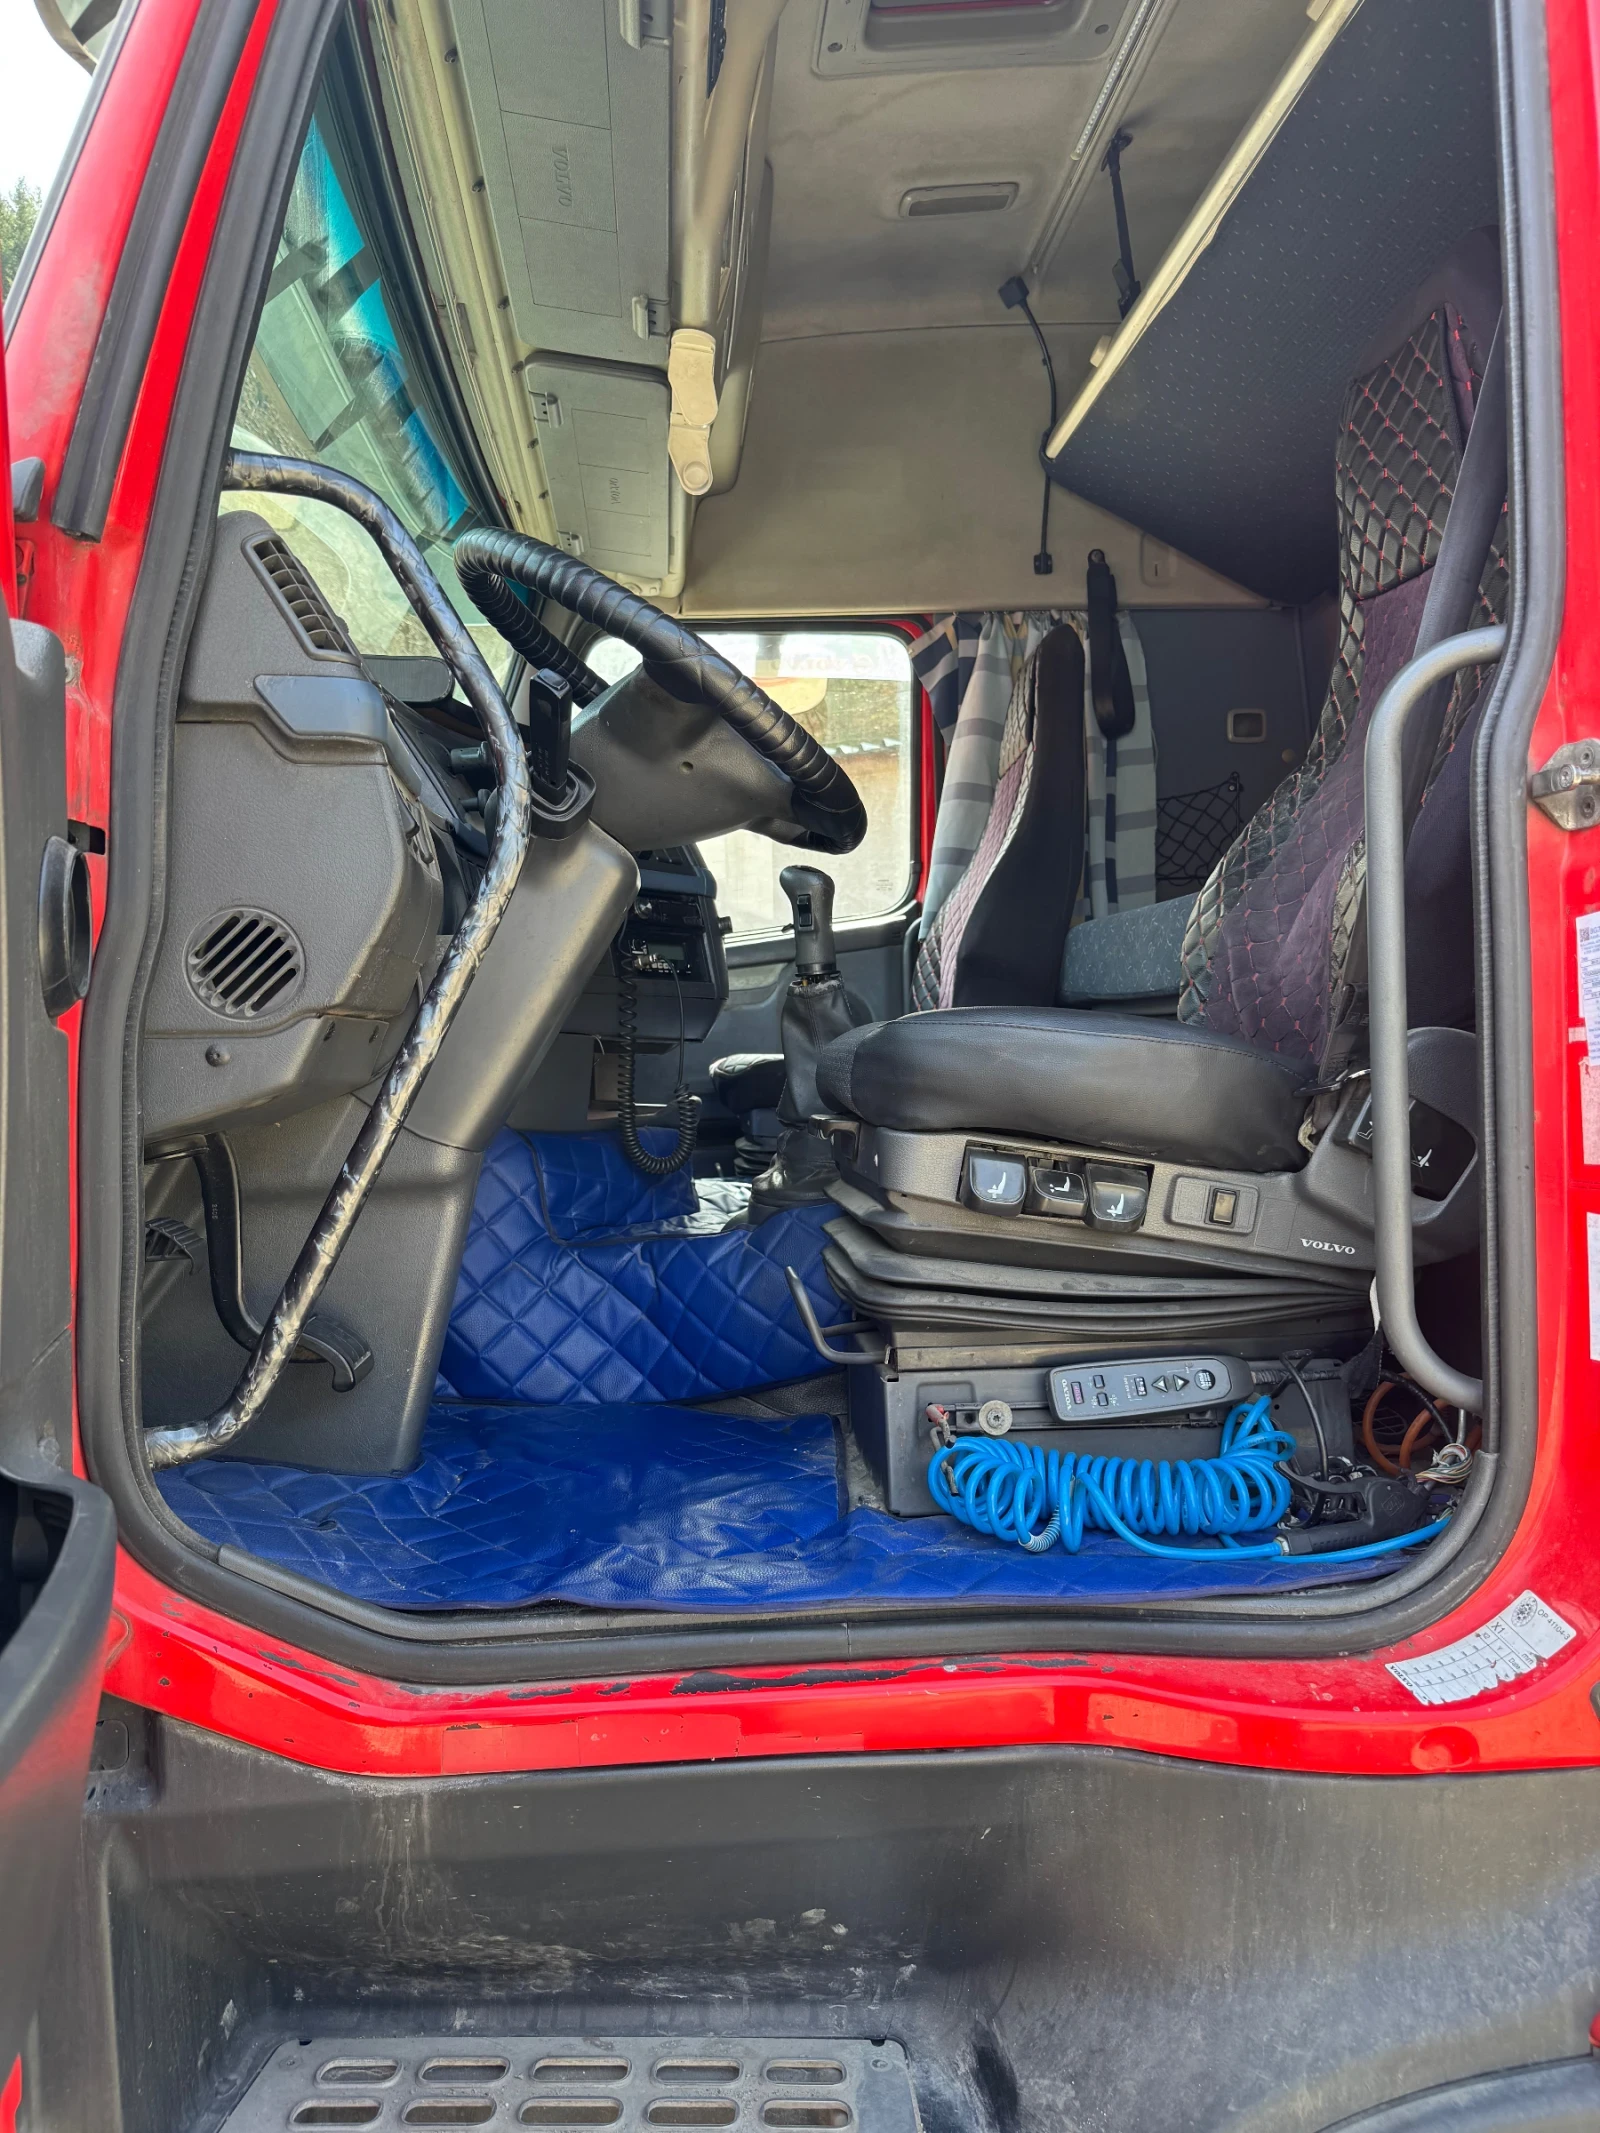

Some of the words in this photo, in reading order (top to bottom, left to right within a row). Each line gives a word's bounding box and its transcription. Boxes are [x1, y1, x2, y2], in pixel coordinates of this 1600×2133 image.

[552, 145, 573, 207] VOLVO
[1300, 1238, 1356, 1255] VOLVO
[1061, 1378, 1072, 1411] VOLVO
[1537, 1608, 1549, 1618] OP
[1547, 1618, 1571, 1640] 41104-3
[1491, 1621, 1506, 1634] X1
[1521, 1653, 1534, 1665] mm
[1389, 1665, 1413, 1688] VOLVO
